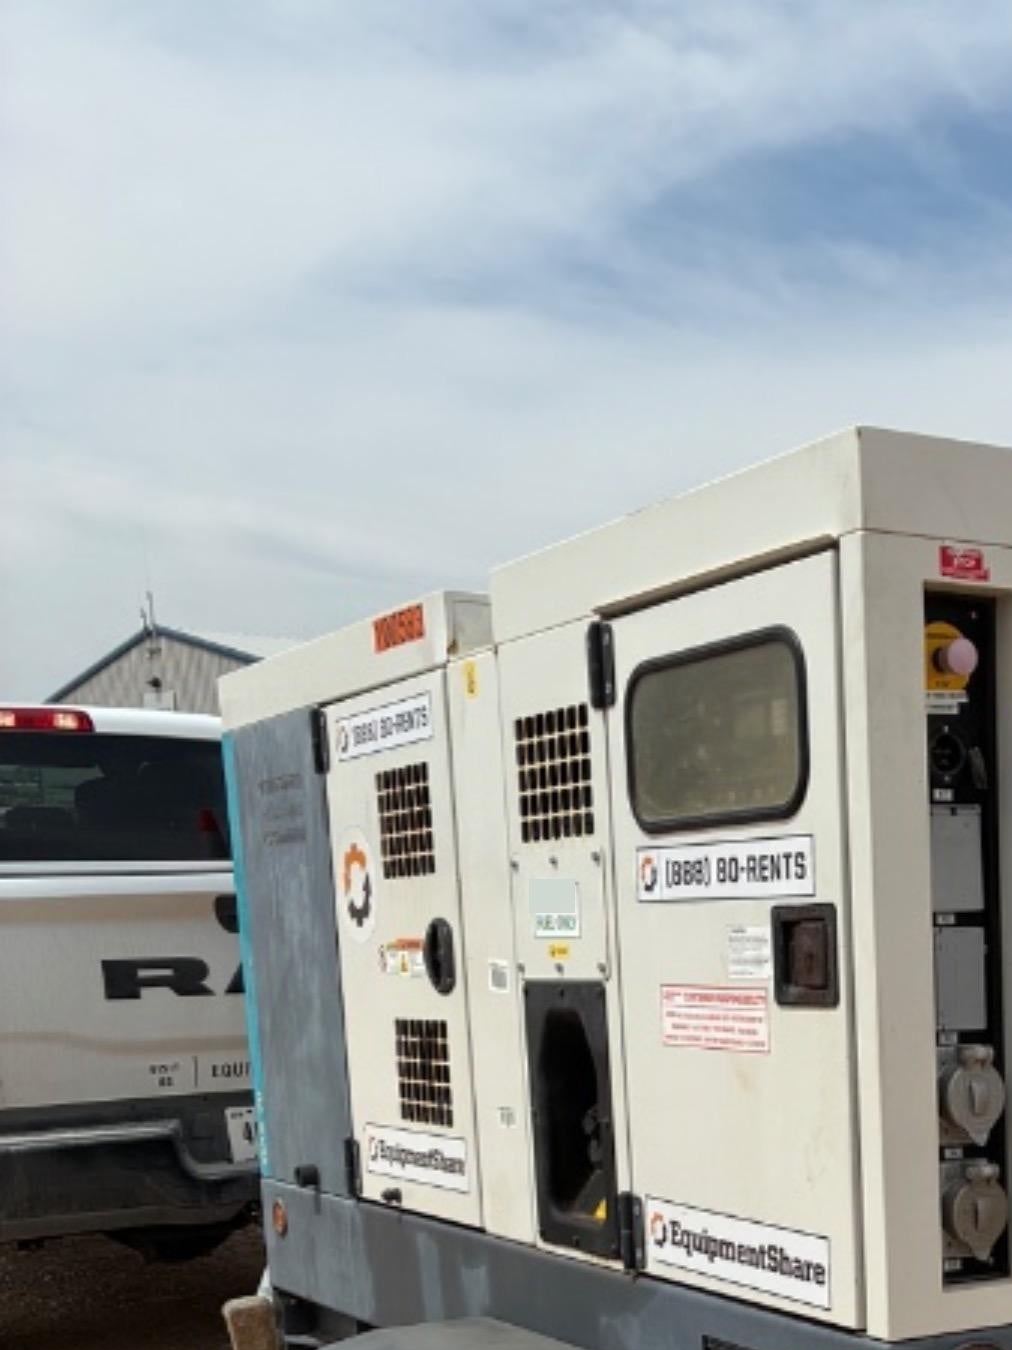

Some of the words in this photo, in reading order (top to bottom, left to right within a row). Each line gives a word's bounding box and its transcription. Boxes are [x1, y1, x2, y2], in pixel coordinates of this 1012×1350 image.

[716, 851, 807, 884] 80-RENTS
[378, 1139, 465, 1177] EquipmentShare
[669, 1219, 826, 1286] EquipmentShare
